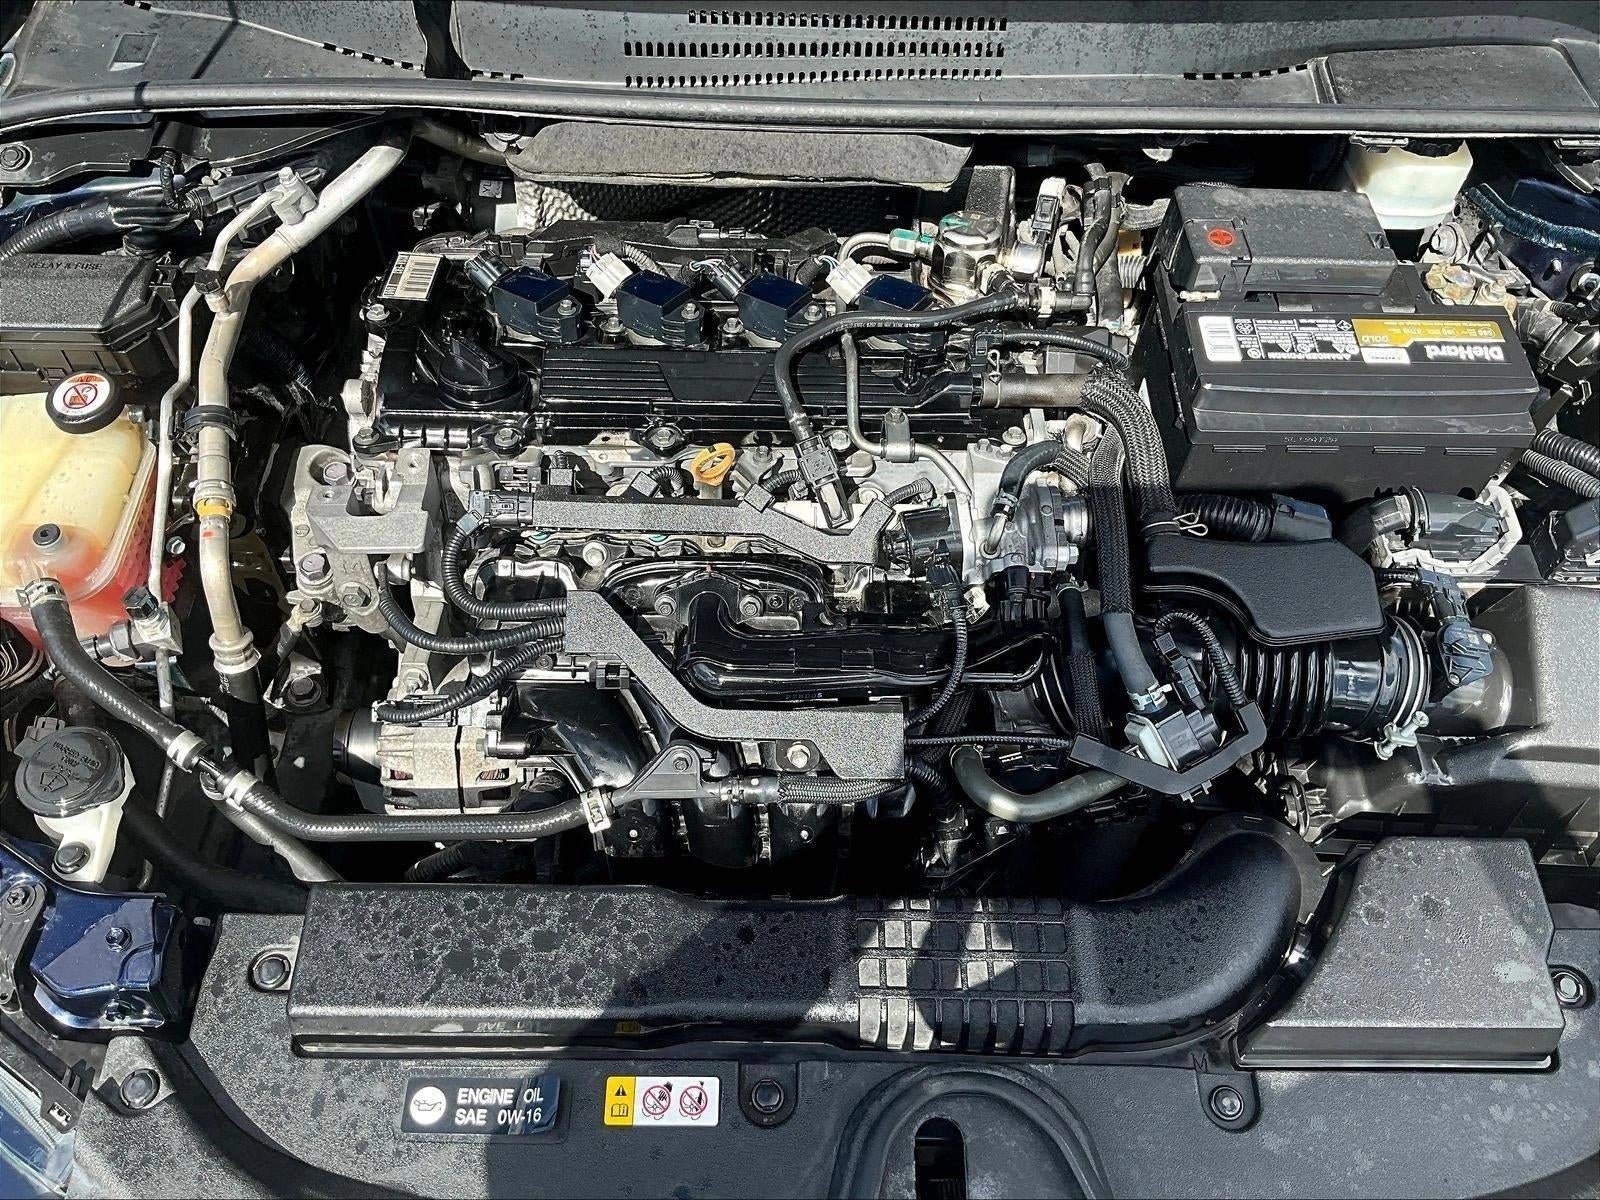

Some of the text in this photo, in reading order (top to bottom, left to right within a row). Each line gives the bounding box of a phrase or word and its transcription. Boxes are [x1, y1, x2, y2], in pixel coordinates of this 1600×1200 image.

[27, 261, 62, 270] RELAY
[74, 262, 103, 270] FUSE
[1362, 335, 1388, 343] GOLD
[1424, 345, 1505, 361] DieHard
[52, 741, 80, 757] WASHER
[456, 1087, 544, 1105] ENGINE OIL
[454, 1108, 542, 1125] SAE 0W-16
